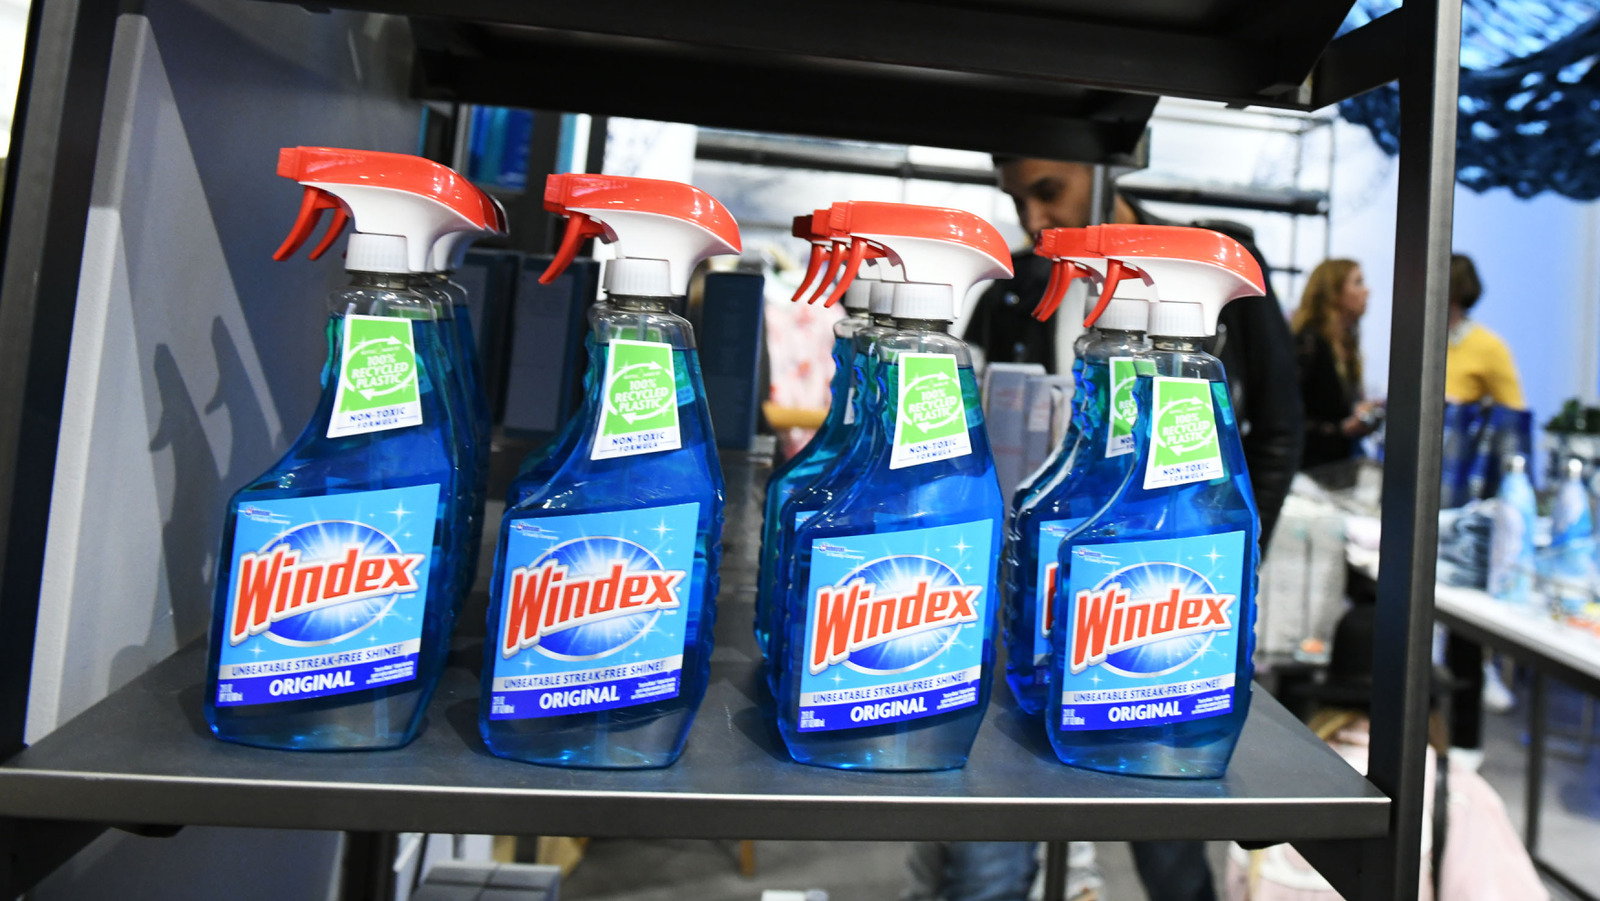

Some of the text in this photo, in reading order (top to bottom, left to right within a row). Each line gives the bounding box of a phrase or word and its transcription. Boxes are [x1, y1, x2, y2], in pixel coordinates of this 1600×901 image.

[368, 354, 395, 366] 100%
[352, 363, 408, 379] RECYCLED
[357, 374, 401, 389] PLASTIC
[631, 379, 656, 391] 100%
[616, 388, 667, 403] RECYCLED
[922, 389, 945, 401] 100%
[620, 399, 661, 412] PLASTIC
[910, 397, 956, 413] RECYCLED
[351, 408, 405, 421] NON-TOXIC
[914, 408, 952, 423] PLASTIC
[1176, 414, 1198, 424] 100%
[1163, 422, 1210, 436] RECYCLED
[613, 433, 664, 445] NON-TOXIC
[1168, 432, 1204, 445] PLASTIC
[911, 440, 956, 454] NON-TOXIC
[1164, 463, 1209, 475] NON-TOXIC
[231, 545, 420, 641] Windex
[504, 562, 681, 655] Windex
[811, 579, 978, 671] Windex
[1072, 585, 1232, 671] Windex
[232, 661, 292, 676] UNBEATABLE
[295, 651, 362, 670] STREAK-FREE
[269, 670, 355, 696] ORIGINAL
[504, 673, 560, 688] UNBEATABLE
[563, 666, 627, 684] STREAK-FREE
[539, 685, 620, 710] ORIGINAL
[813, 687, 870, 704] UNBEATABLE
[873, 679, 933, 697] STREAK-FREE
[1073, 689, 1127, 702] UNBEATABLE
[1130, 684, 1187, 699] STREAK-FREE
[850, 697, 927, 722] ORIGINAL
[1108, 701, 1182, 722] ORIGINAL
